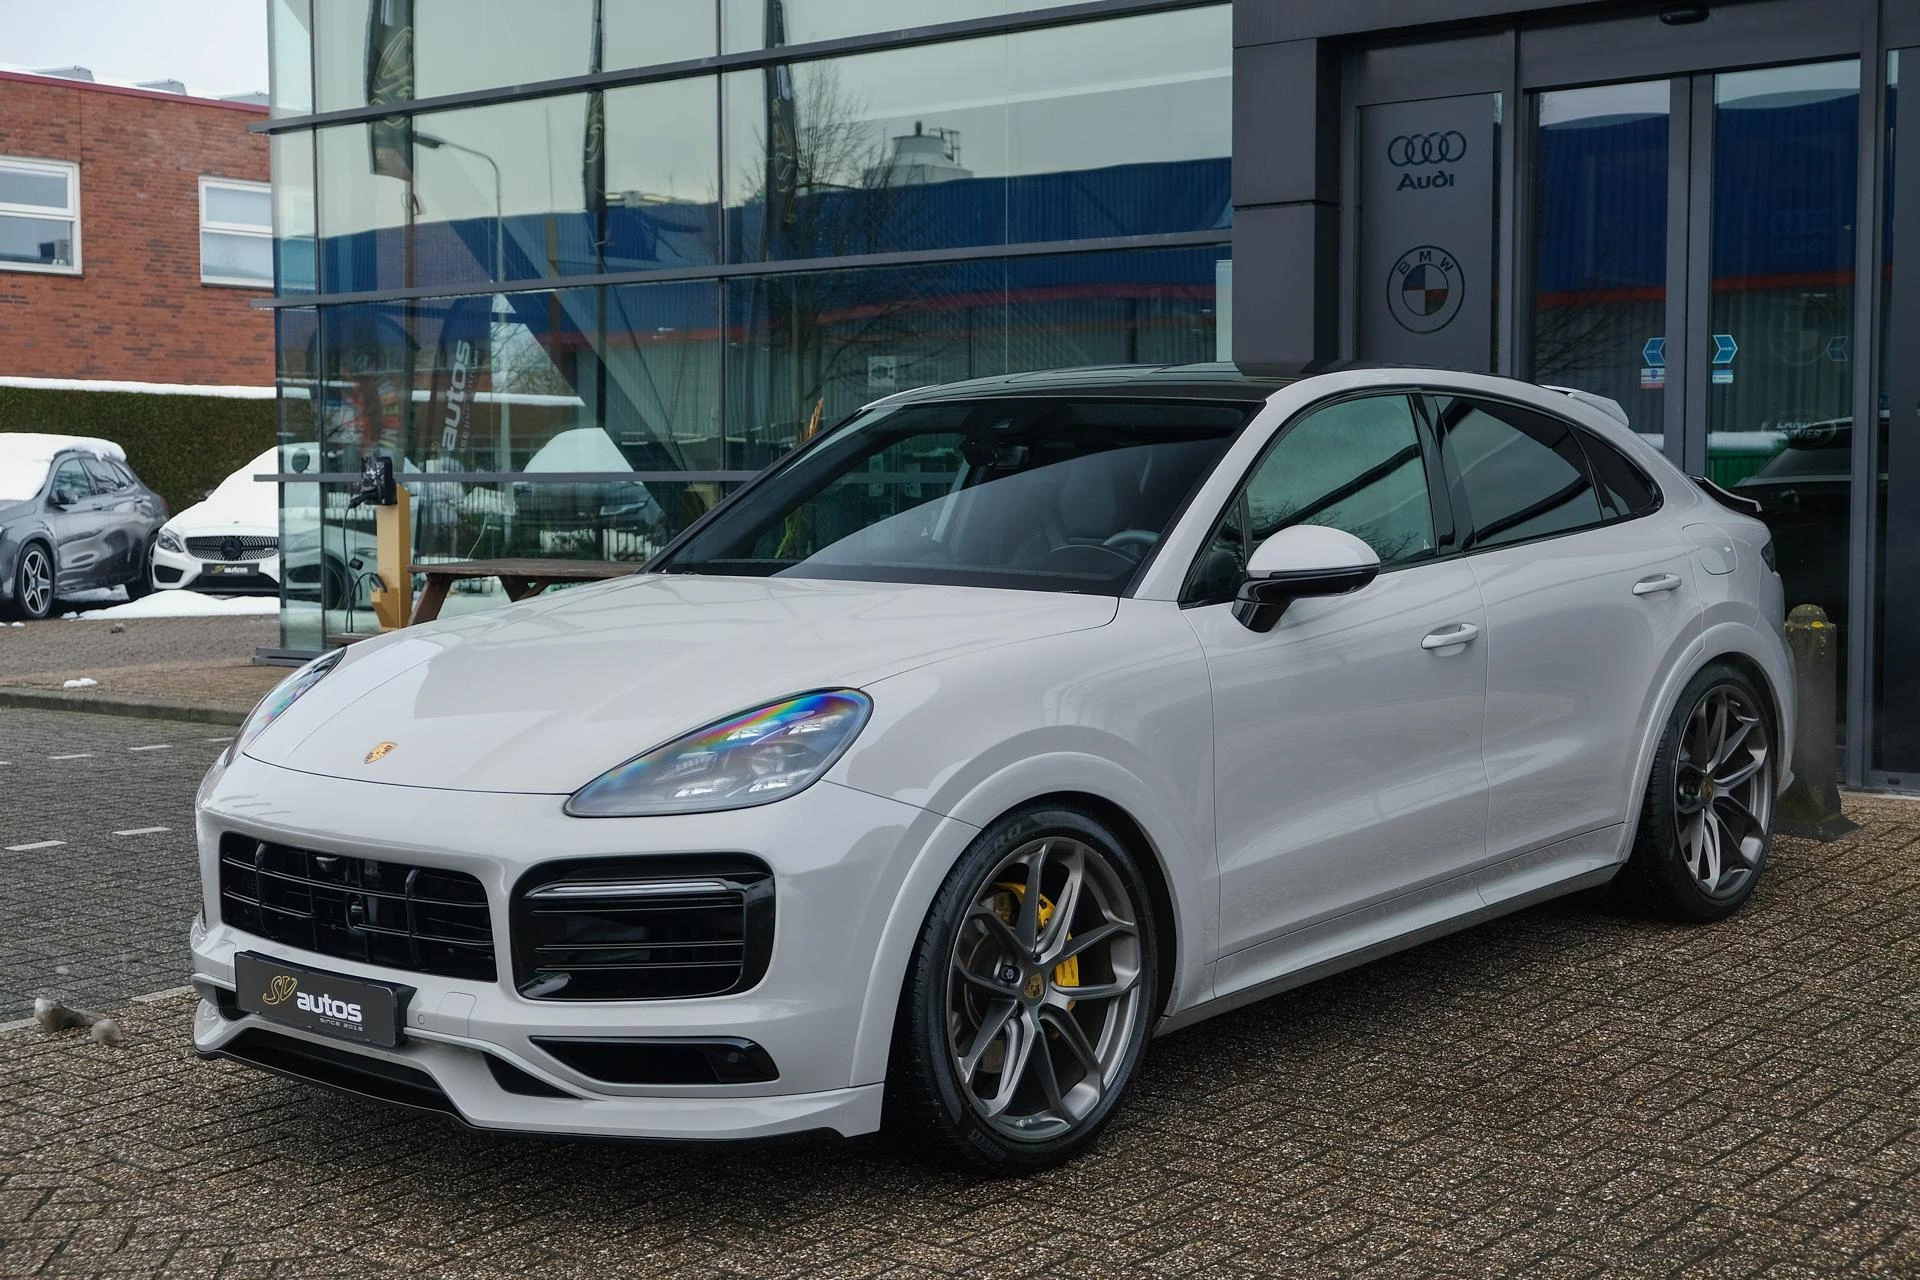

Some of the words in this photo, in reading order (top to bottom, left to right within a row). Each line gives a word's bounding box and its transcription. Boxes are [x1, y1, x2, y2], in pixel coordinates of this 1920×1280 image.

[1397, 171, 1454, 191] Audi
[1397, 250, 1454, 276] BMW
[441, 339, 471, 451] autos
[263, 975, 298, 1005] SV
[296, 991, 362, 1022] autos
